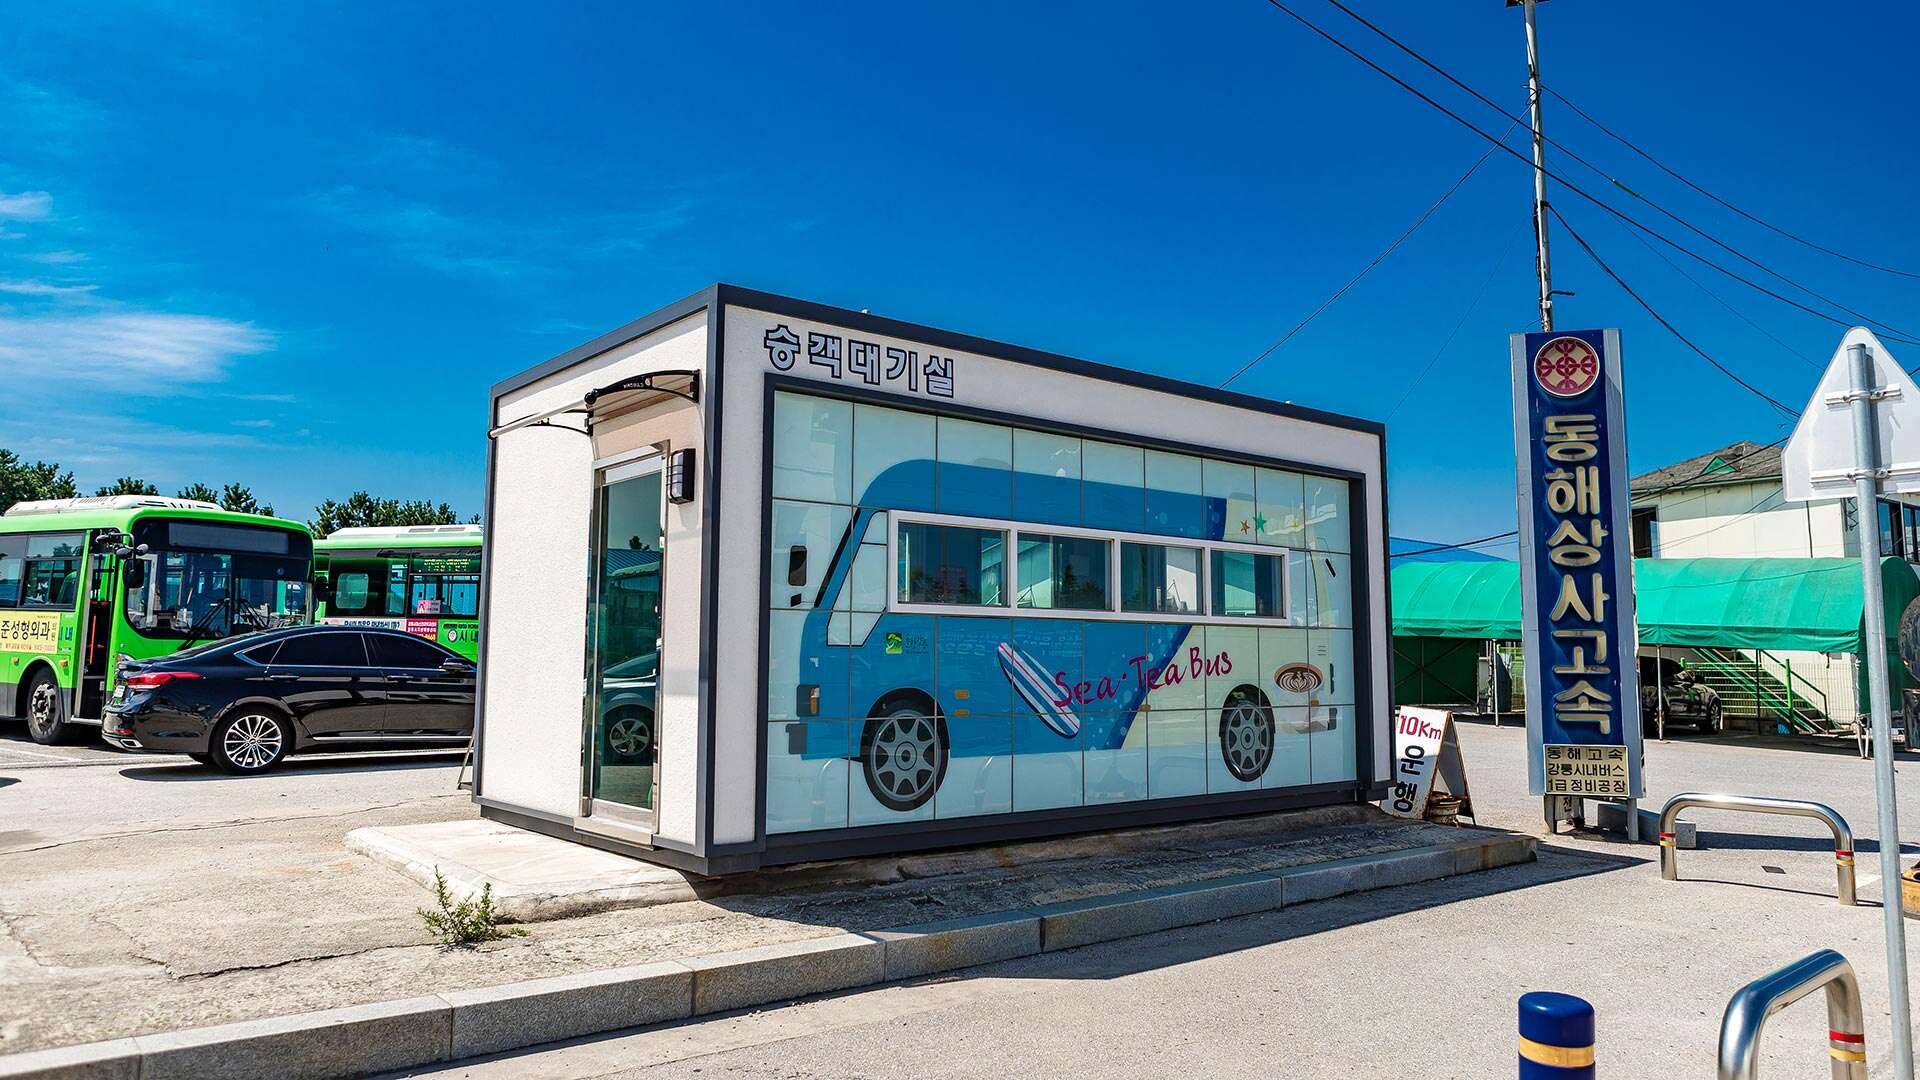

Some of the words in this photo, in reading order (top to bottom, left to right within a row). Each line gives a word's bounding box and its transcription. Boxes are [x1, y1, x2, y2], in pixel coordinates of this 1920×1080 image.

[764, 324, 954, 398] 승객대기실
[1544, 414, 1613, 735] 동해상사고속
[1190, 646, 1233, 679] Bus
[1399, 715, 1442, 740] 10Km
[1393, 745, 1425, 813] 운행
